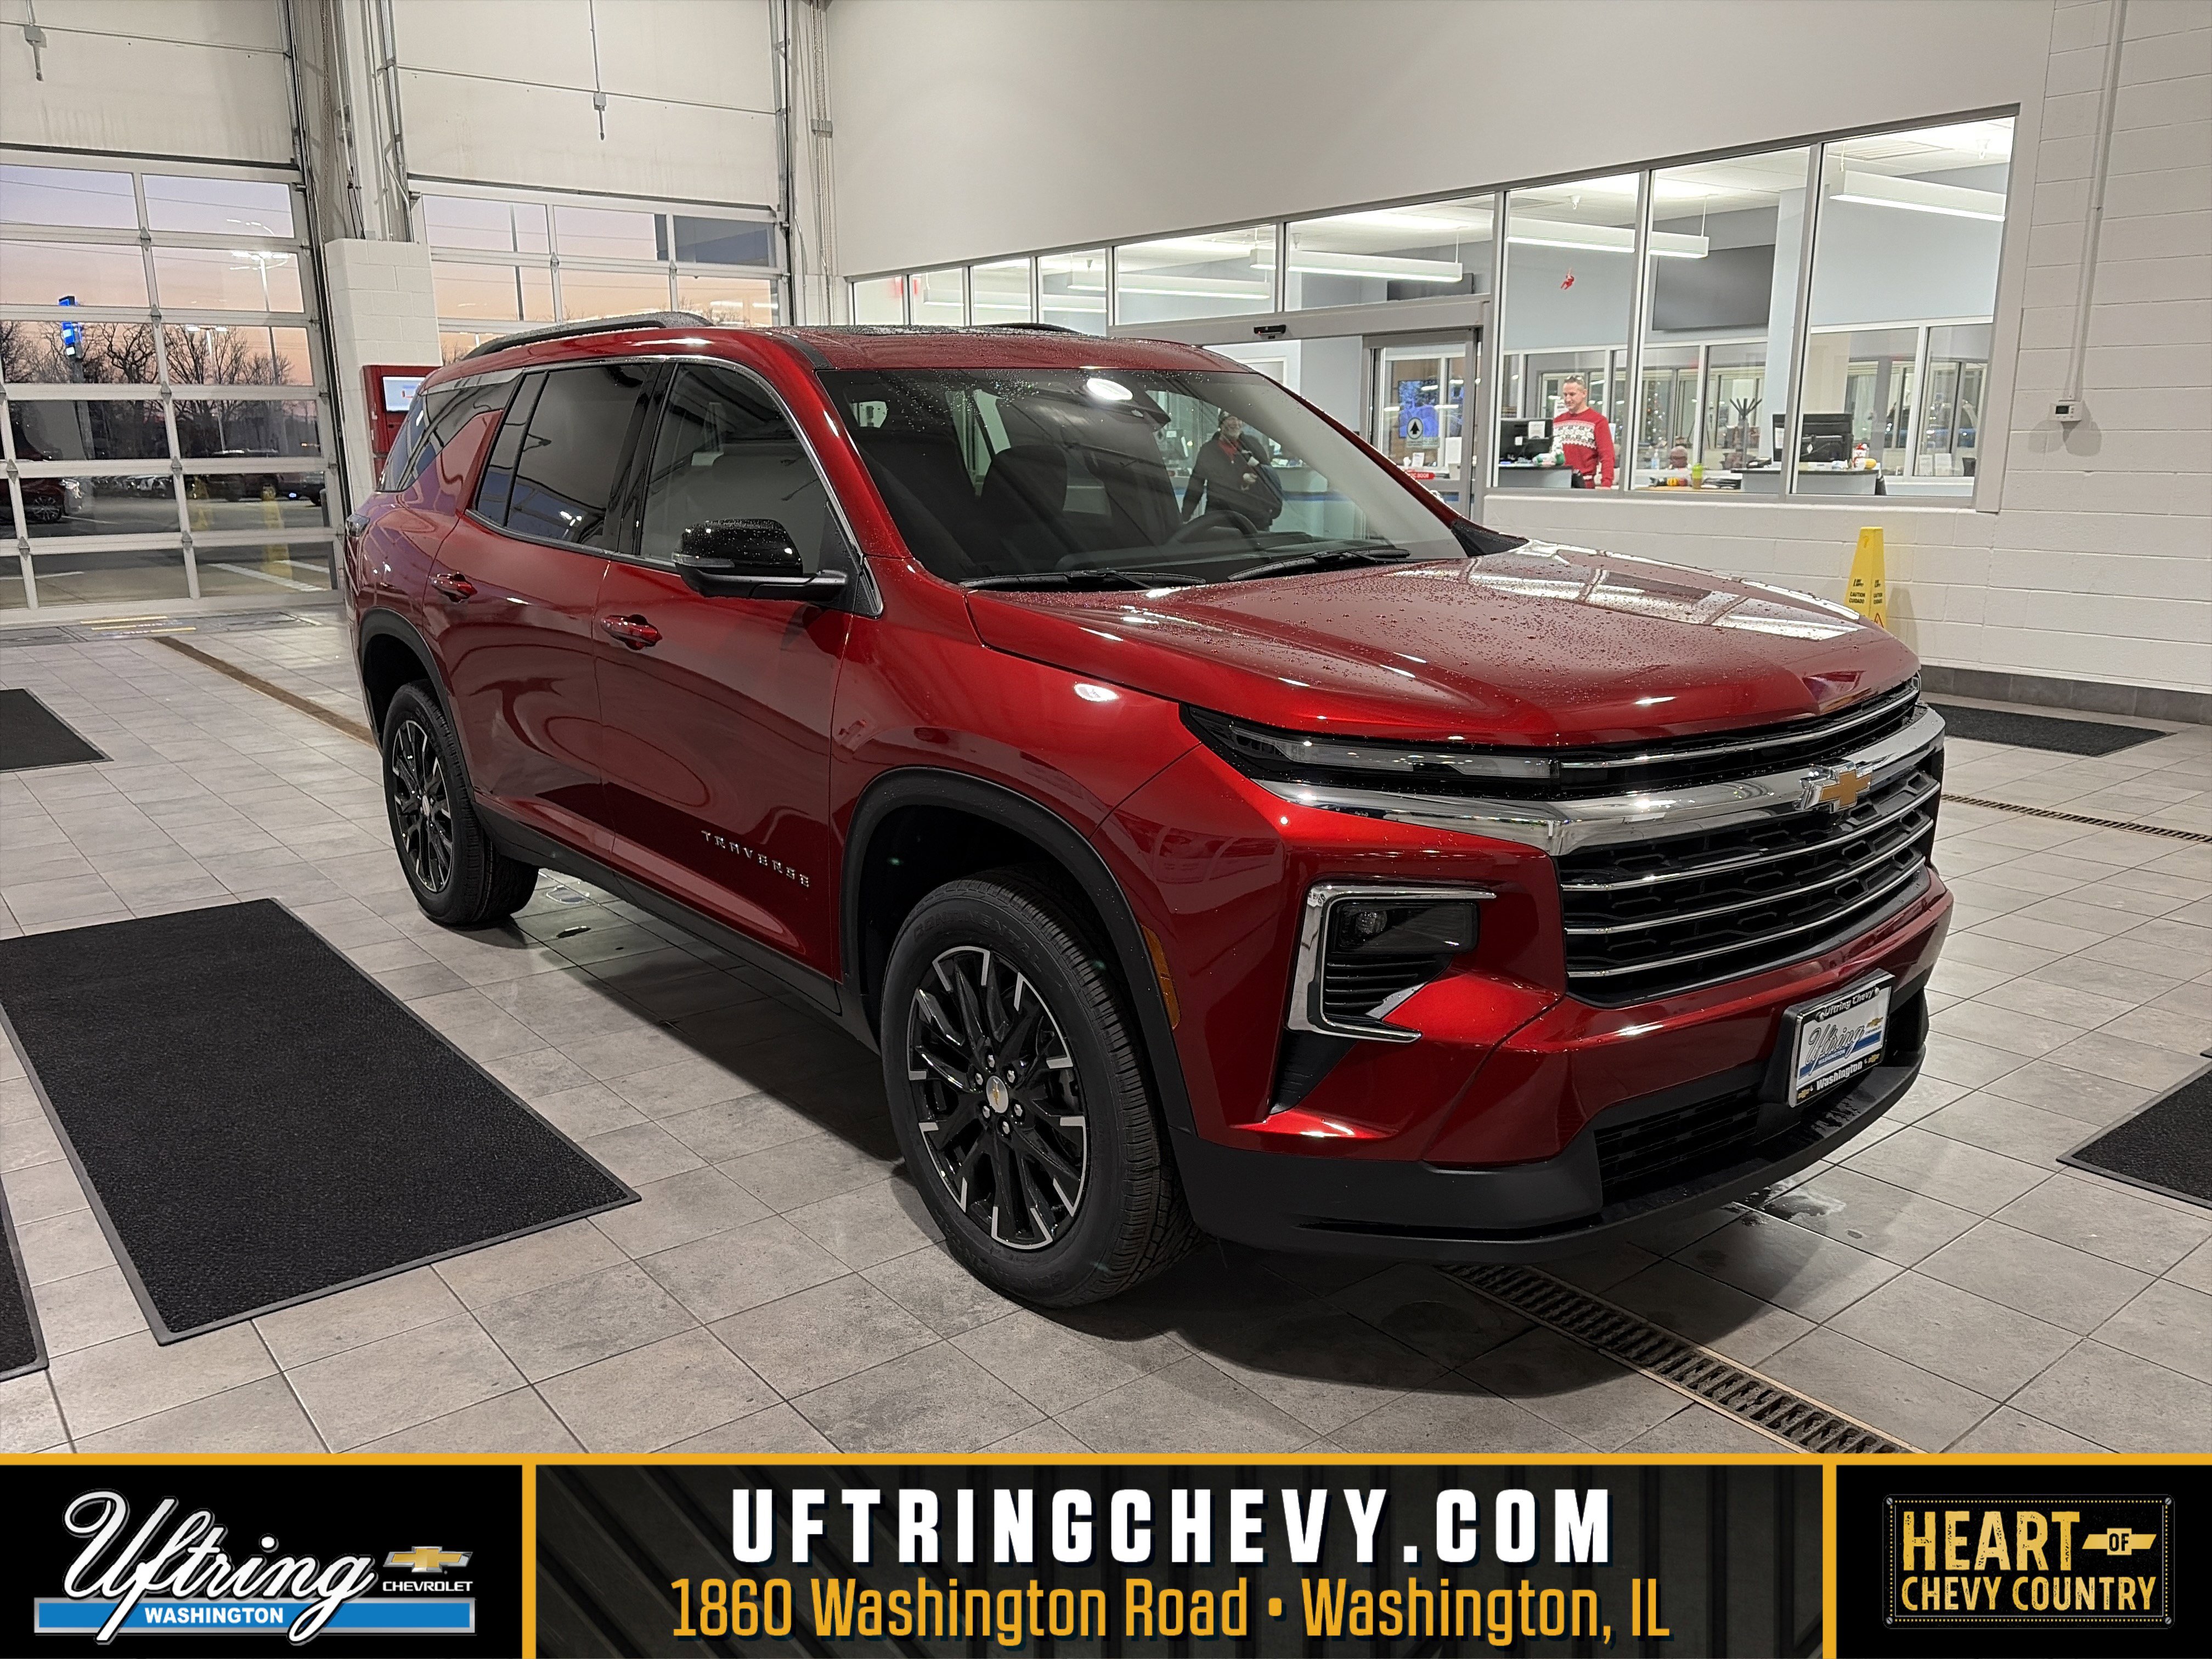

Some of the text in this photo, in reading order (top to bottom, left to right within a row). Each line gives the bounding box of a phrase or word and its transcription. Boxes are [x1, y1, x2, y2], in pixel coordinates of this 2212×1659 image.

[701, 830, 810, 888] TRAVERSE
[1825, 989, 1874, 1017] Uftring Chevy
[1807, 1023, 1865, 1076] Uftring
[1818, 1049, 1846, 1065] WASHINGTON
[1816, 1060, 1863, 1090] Washington
